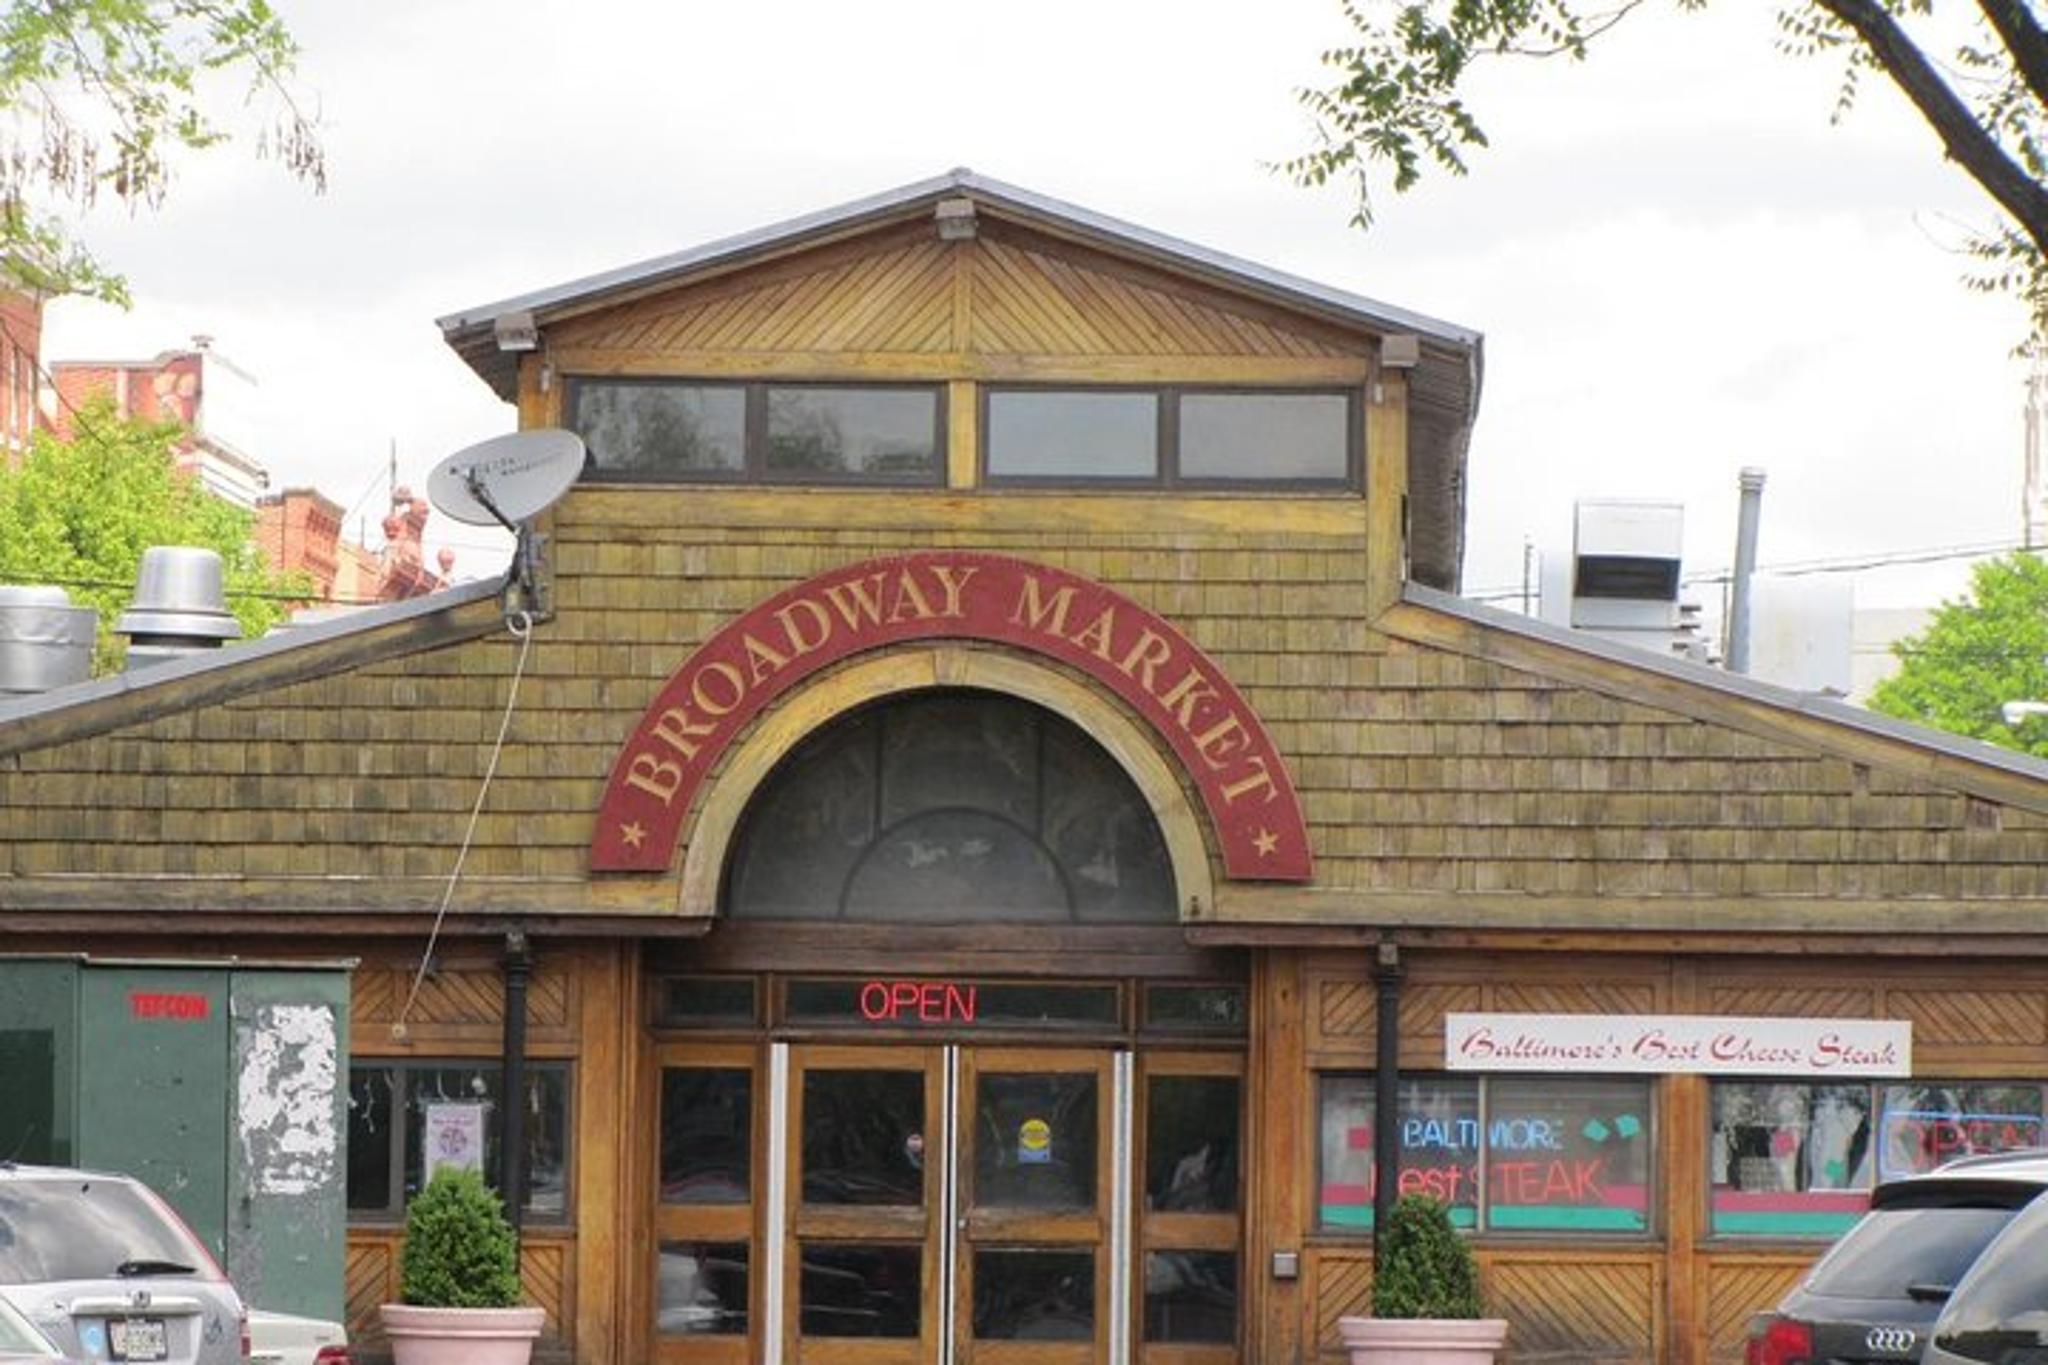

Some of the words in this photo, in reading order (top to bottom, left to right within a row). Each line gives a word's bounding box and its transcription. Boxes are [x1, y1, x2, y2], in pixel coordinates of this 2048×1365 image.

[624, 564, 980, 808] BROADWAY
[1008, 573, 1279, 805] MARKET
[861, 980, 977, 1022] OPEN
[1461, 1028, 1622, 1059] Baltimore's
[1631, 1029, 1700, 1061] Best
[1710, 1031, 1802, 1063] Cheese
[1809, 1031, 1897, 1068] Steak
[1403, 1117, 1564, 1150] BALTIMORE
[1369, 1162, 1463, 1202] est
